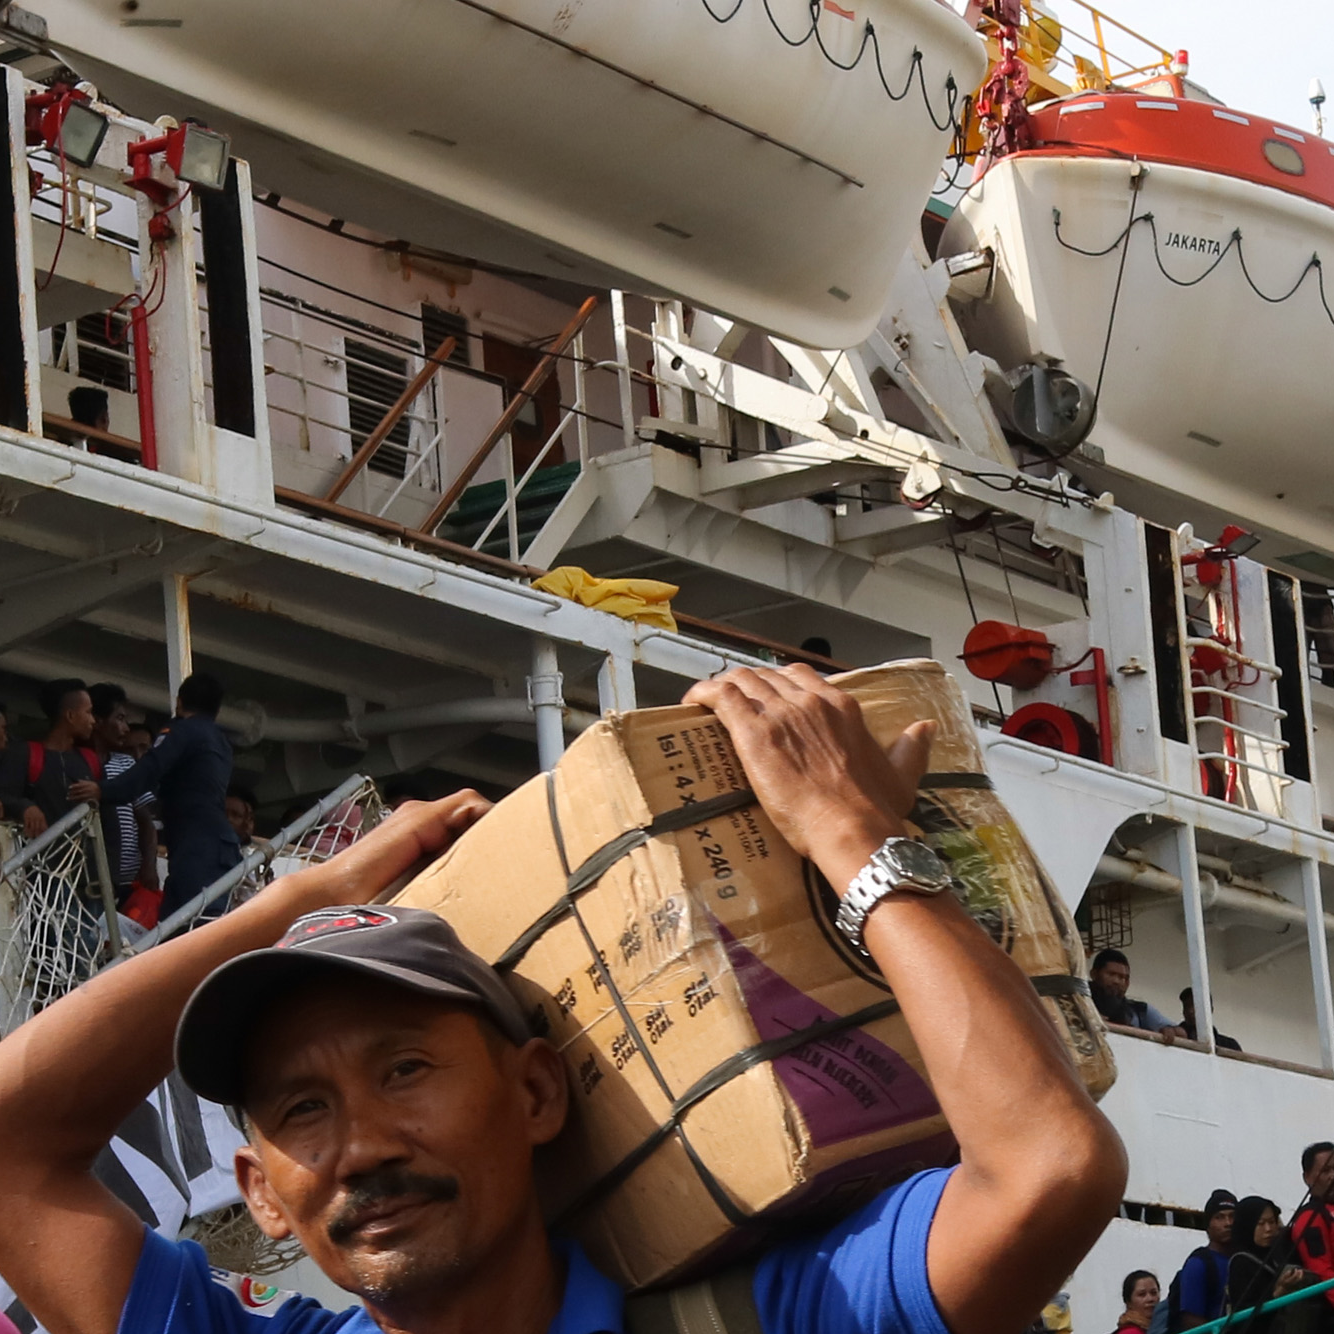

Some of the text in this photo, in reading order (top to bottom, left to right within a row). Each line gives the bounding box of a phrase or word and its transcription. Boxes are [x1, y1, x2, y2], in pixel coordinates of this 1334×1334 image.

[1164, 232, 1221, 256] JAKARTA
[657, 733, 683, 759] Isi
[675, 775, 694, 789] 4
[694, 826, 713, 841] x
[702, 844, 733, 880] 240
[717, 885, 738, 900] g
